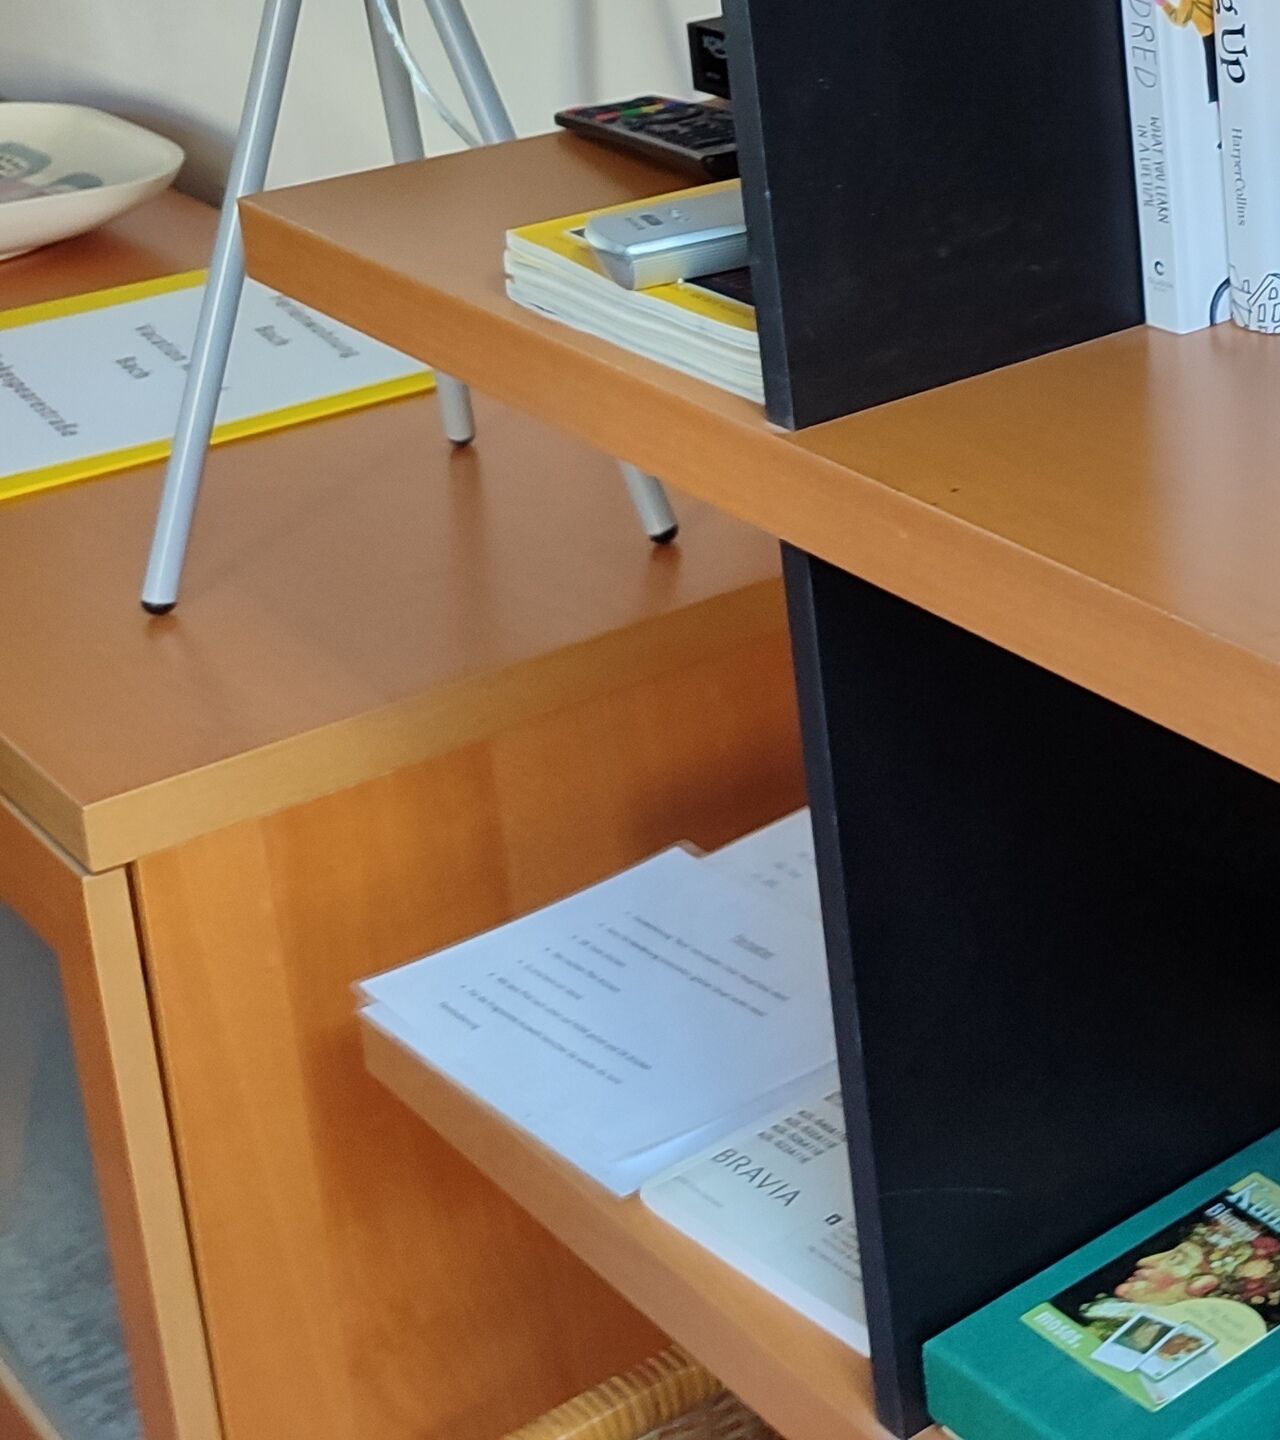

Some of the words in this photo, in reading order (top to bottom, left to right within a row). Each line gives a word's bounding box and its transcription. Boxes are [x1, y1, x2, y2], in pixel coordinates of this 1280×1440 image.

[1220, 23, 1248, 84] Up
[1136, 124, 1149, 138] IN
[1150, 116, 1165, 154] WHAT
[1153, 157, 1166, 182] YOU
[1230, 127, 1247, 227] HarperCollins
[711, 1147, 802, 1208] BRAVIA
